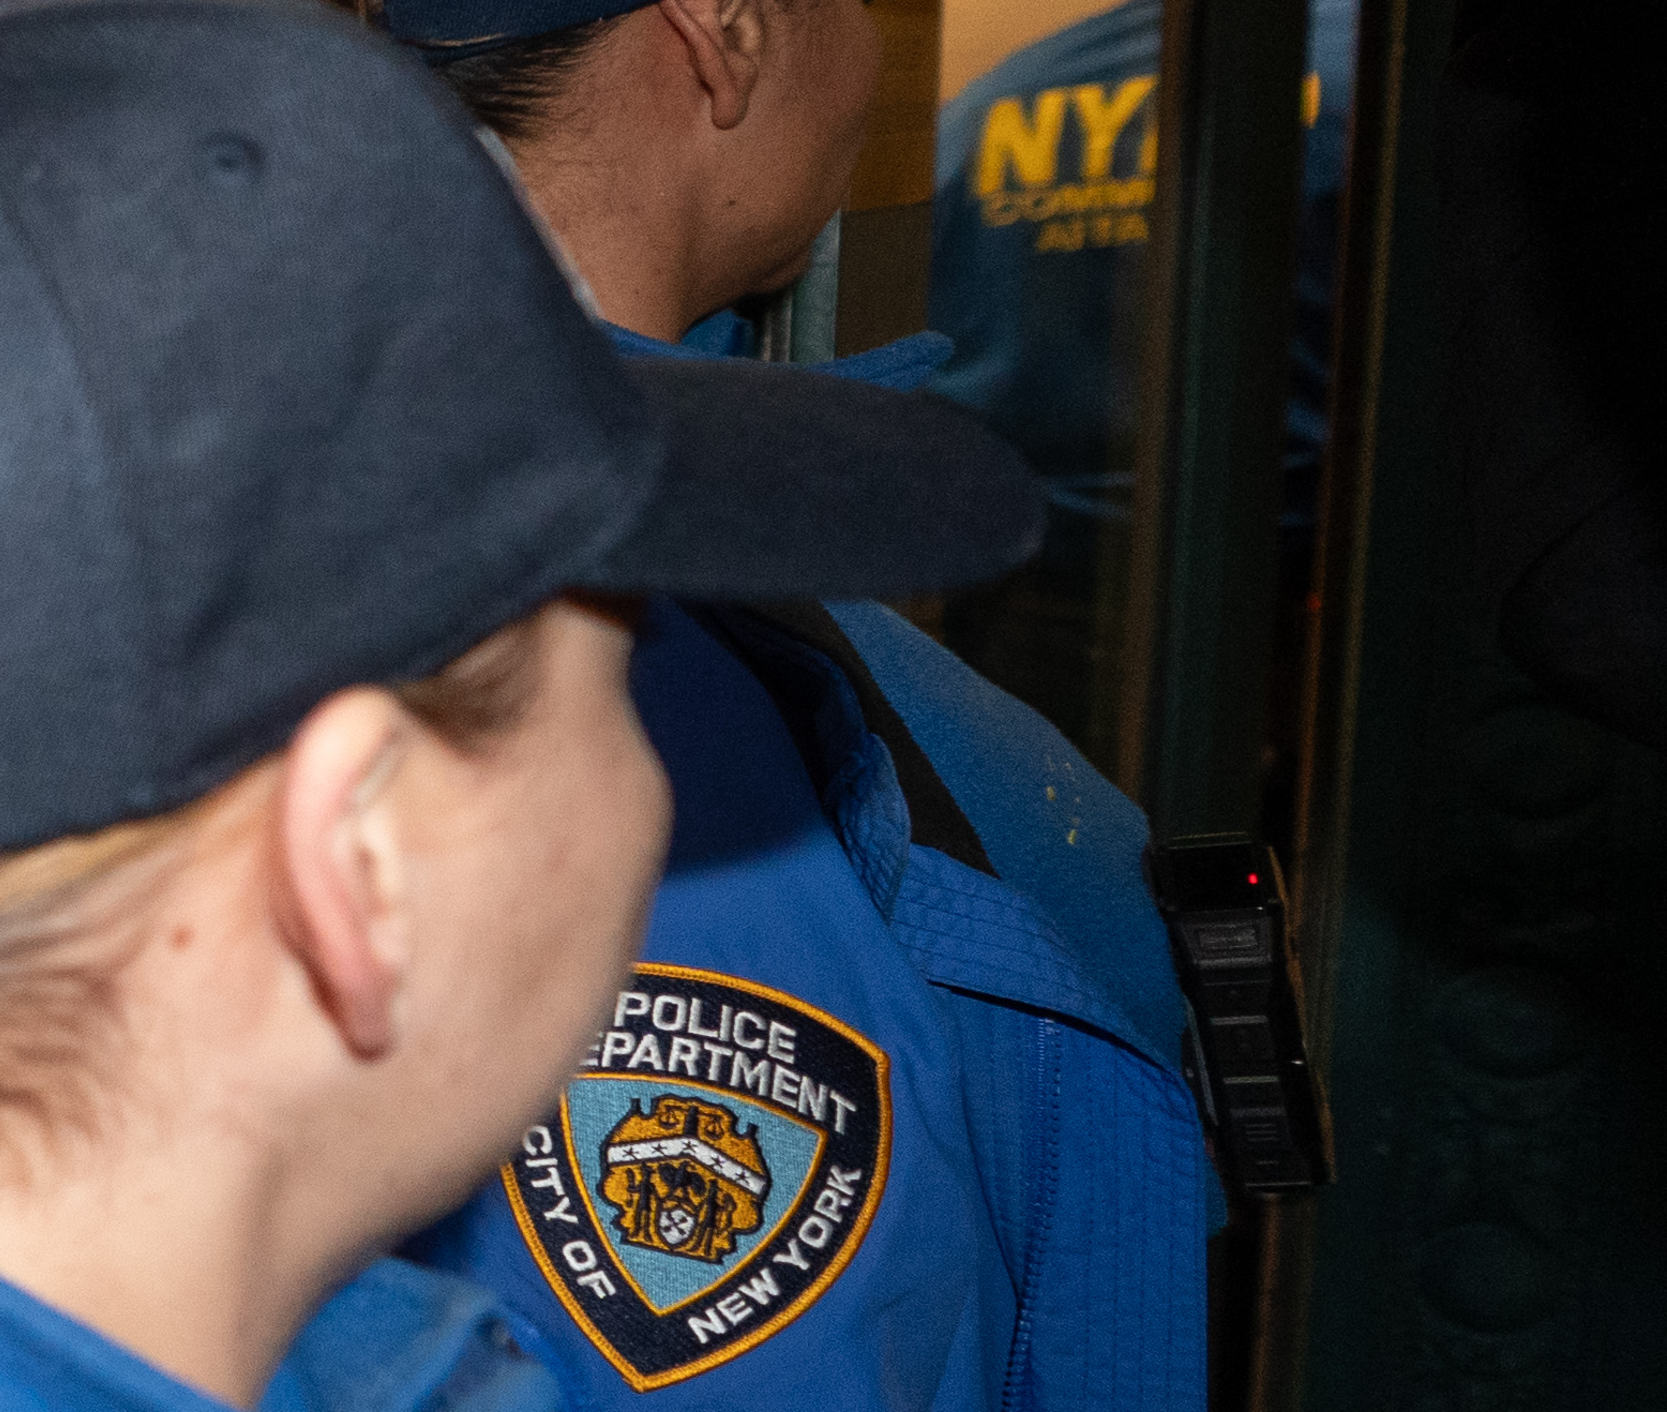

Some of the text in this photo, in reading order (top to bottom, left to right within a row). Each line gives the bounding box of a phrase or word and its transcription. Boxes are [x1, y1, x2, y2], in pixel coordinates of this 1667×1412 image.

[579, 1030, 857, 1134] PARTMENT
[614, 991, 797, 1064] POLICE
[522, 1124, 617, 1300] CITY OF
[686, 1164, 863, 1345] NEW YORK
